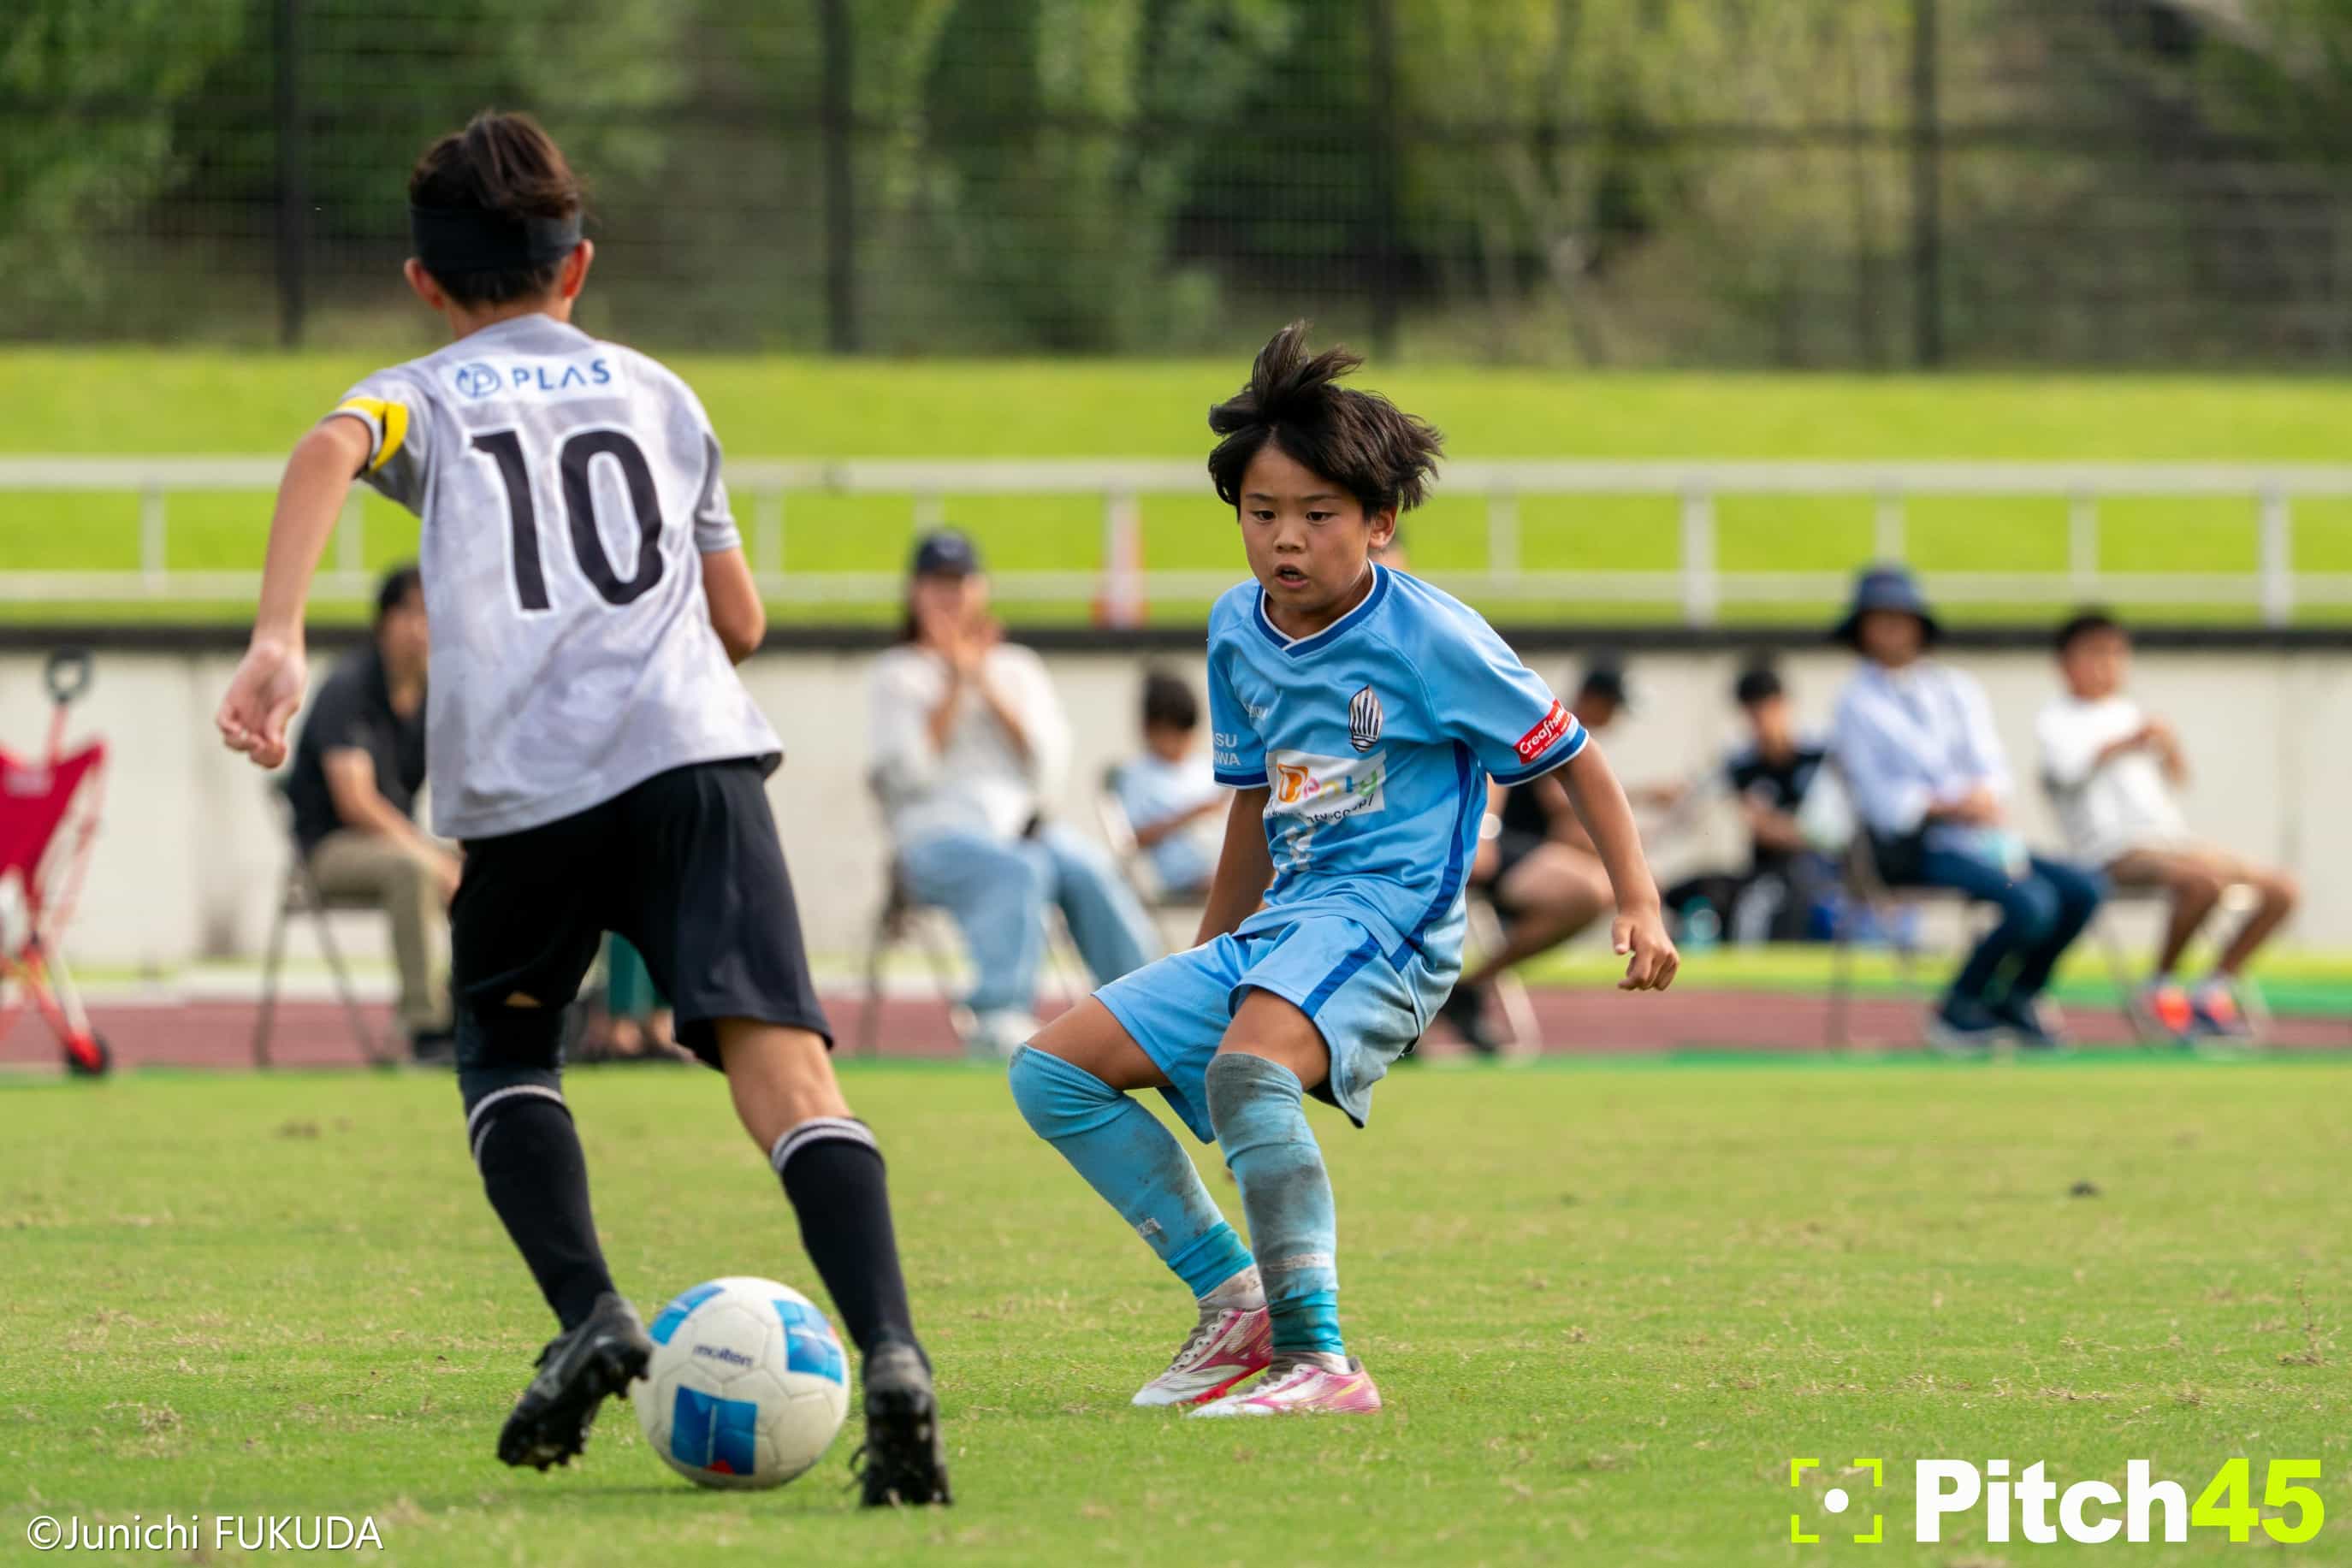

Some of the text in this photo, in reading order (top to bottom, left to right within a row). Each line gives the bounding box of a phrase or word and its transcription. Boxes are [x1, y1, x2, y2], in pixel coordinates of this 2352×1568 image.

[512, 358, 612, 390] PLAS
[471, 428, 665, 611] 10
[692, 1345, 754, 1367] molten
